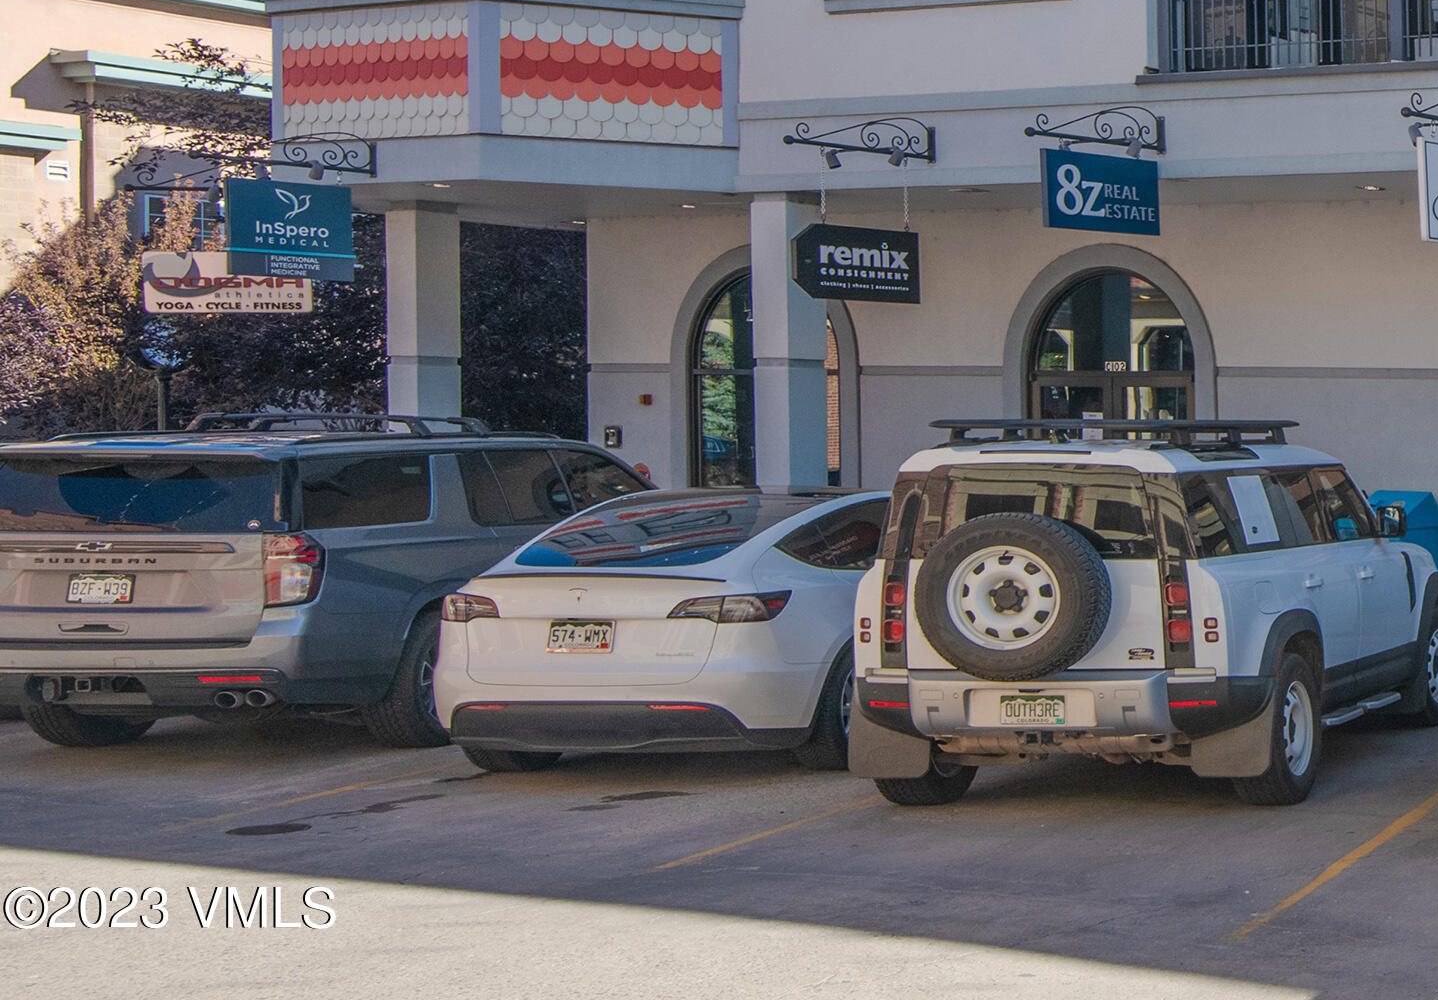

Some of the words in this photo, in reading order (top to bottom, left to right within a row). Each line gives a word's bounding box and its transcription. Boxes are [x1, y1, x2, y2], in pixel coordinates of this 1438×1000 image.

[1104, 183, 1140, 201] REAL
[1105, 204, 1156, 222] ESTATE
[255, 220, 330, 239] InSpero
[255, 236, 330, 248] MEDICAL
[270, 255, 320, 264] FUNCTIONAL
[819, 242, 910, 270] remix
[270, 262, 321, 271] INTEGRATIVE
[270, 268, 308, 277] MEDICINE
[819, 267, 910, 281] CONSIGNMENT
[152, 277, 304, 289] DOGMA
[820, 281, 847, 289] clothing
[875, 284, 910, 292] accessories
[214, 290, 305, 299] athletica
[156, 301, 194, 310] YOGA
[205, 302, 242, 311] CYCLE
[253, 302, 303, 311] FITNESS
[1005, 703, 1061, 718] OUTH3RE
